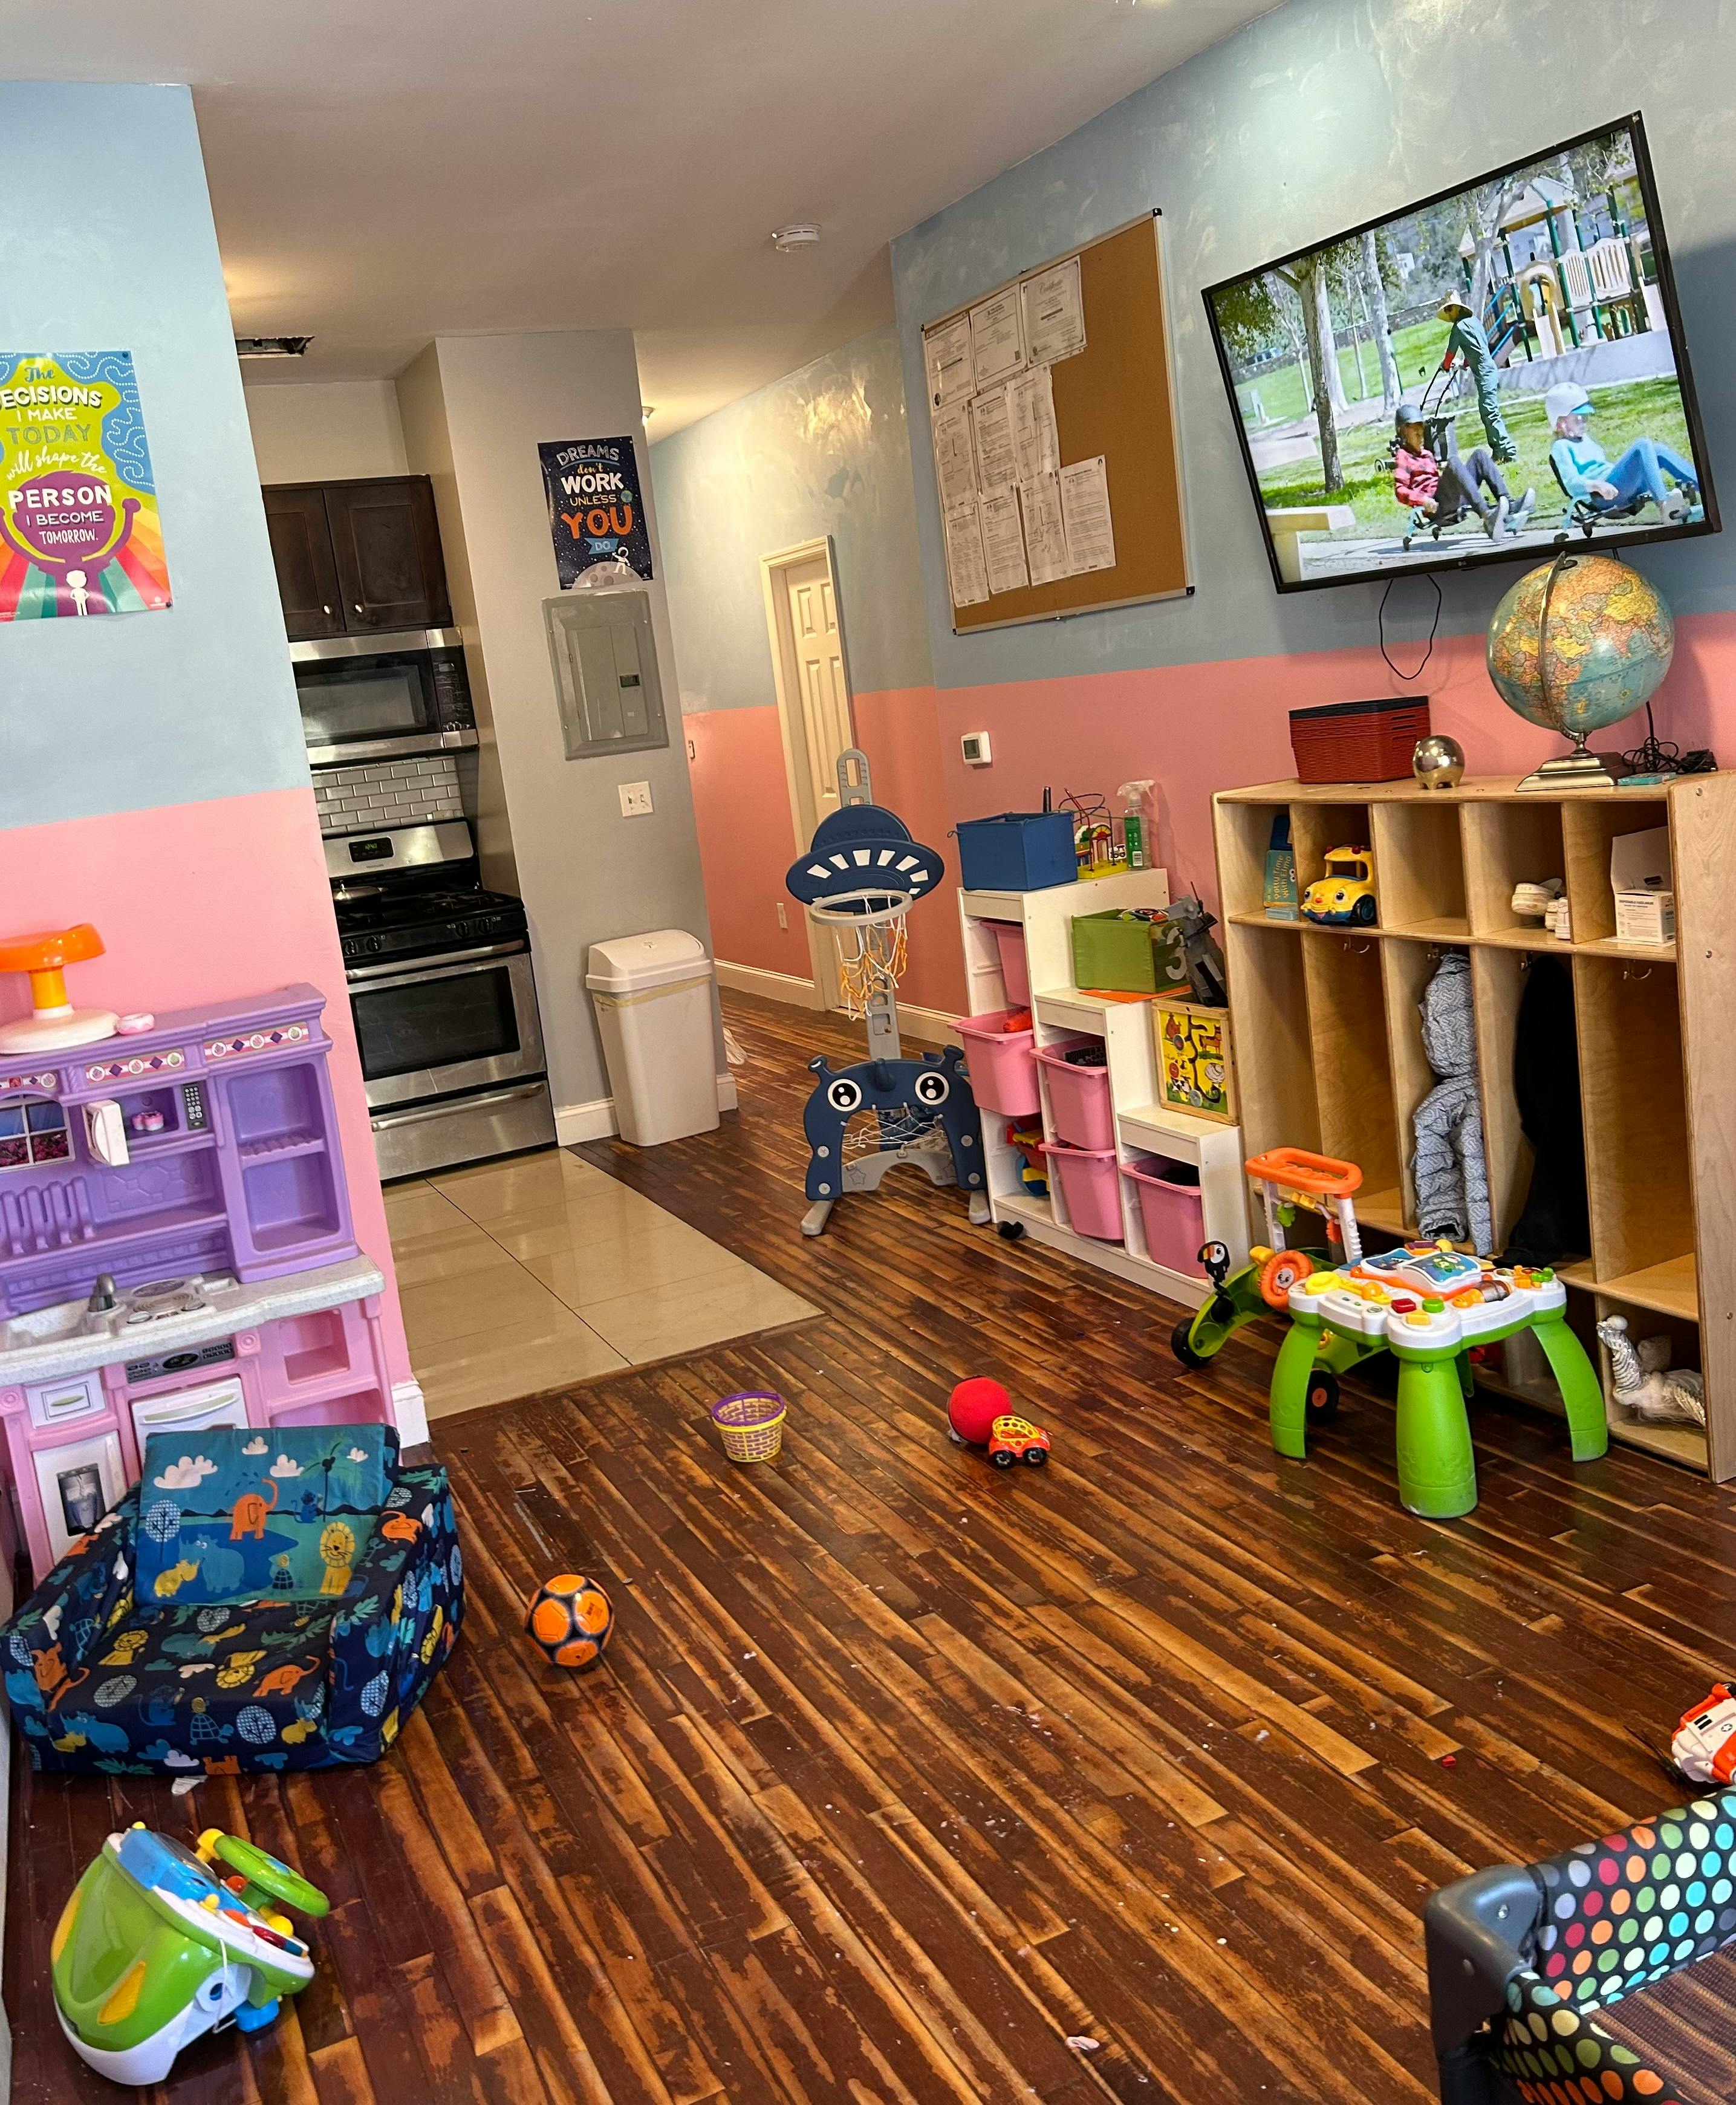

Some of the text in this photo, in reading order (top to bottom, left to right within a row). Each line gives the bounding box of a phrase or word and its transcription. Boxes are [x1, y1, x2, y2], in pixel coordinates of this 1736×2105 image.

[24, 367, 55, 382] The
[0, 385, 102, 409] ECISIONS
[17, 407, 77, 422] I MAKE
[5, 424, 91, 444] TODAY
[7, 445, 107, 480] will shape the
[556, 444, 619, 466] DREAMS
[577, 462, 603, 474] don't
[561, 473, 623, 495] WORK
[8, 485, 112, 510] PERSON
[570, 494, 617, 506] UNLESS
[27, 510, 104, 527] I BECOME
[561, 506, 632, 539] YOU
[39, 529, 99, 544] TOMORROW.
[1280, 856, 1292, 877] Elmo
